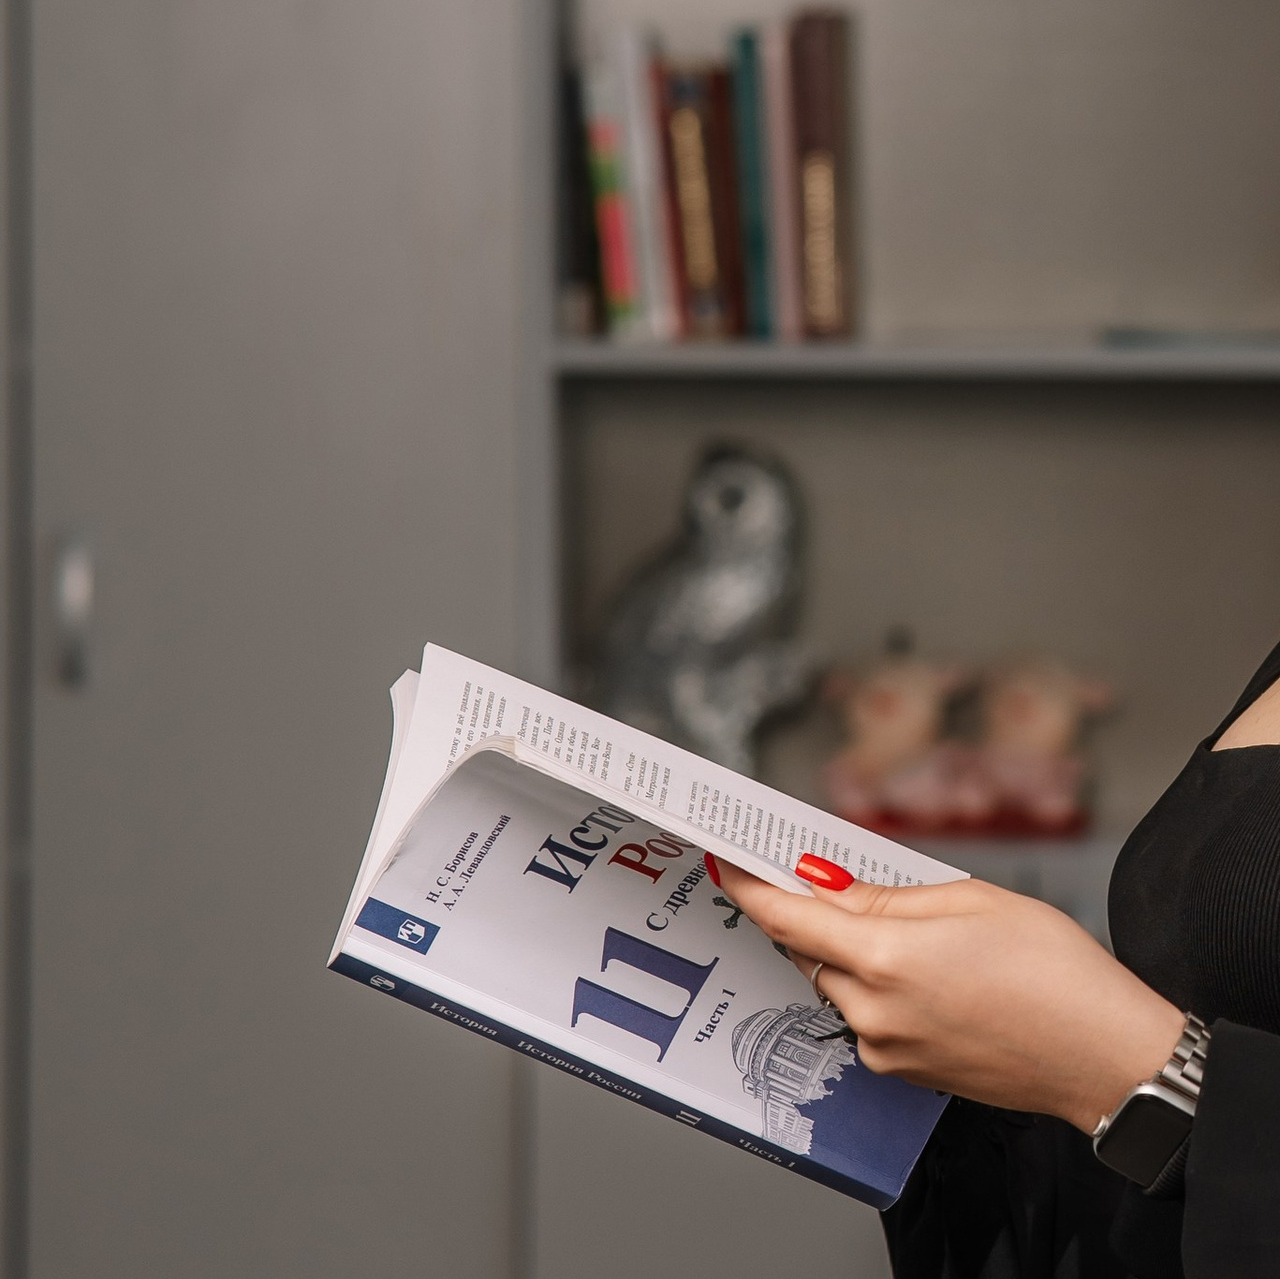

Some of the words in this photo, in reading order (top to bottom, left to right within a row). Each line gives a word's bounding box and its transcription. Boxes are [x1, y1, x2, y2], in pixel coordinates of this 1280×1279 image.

[449, 737, 461, 757] этому
[460, 681, 472, 713] правление
[483, 691, 496, 729] единственно
[517, 706, 531, 741] -Восточной
[543, 716, 555, 736] После
[554, 721, 567, 744] Однако
[645, 761, 660, 800] Митрополит
[708, 805, 719, 822] Петра
[741, 813, 752, 838] Невского
[425, 890, 442, 903] Н.
[436, 876, 451, 887] С.
[444, 831, 479, 873] Борисов
[443, 899, 457, 911] А.
[451, 885, 465, 897] А.
[459, 814, 511, 883] Левандовский
[523, 804, 636, 894] Исто
[645, 911, 669, 932] С
[571, 925, 720, 1063] 11
[430, 1002, 498, 1036] История
[694, 1001, 730, 1044] Часть
[722, 988, 737, 999] 1
[517, 1040, 584, 1074] История
[587, 1071, 642, 1100] России
[676, 1110, 702, 1126] 11
[739, 1138, 782, 1163] Часть
